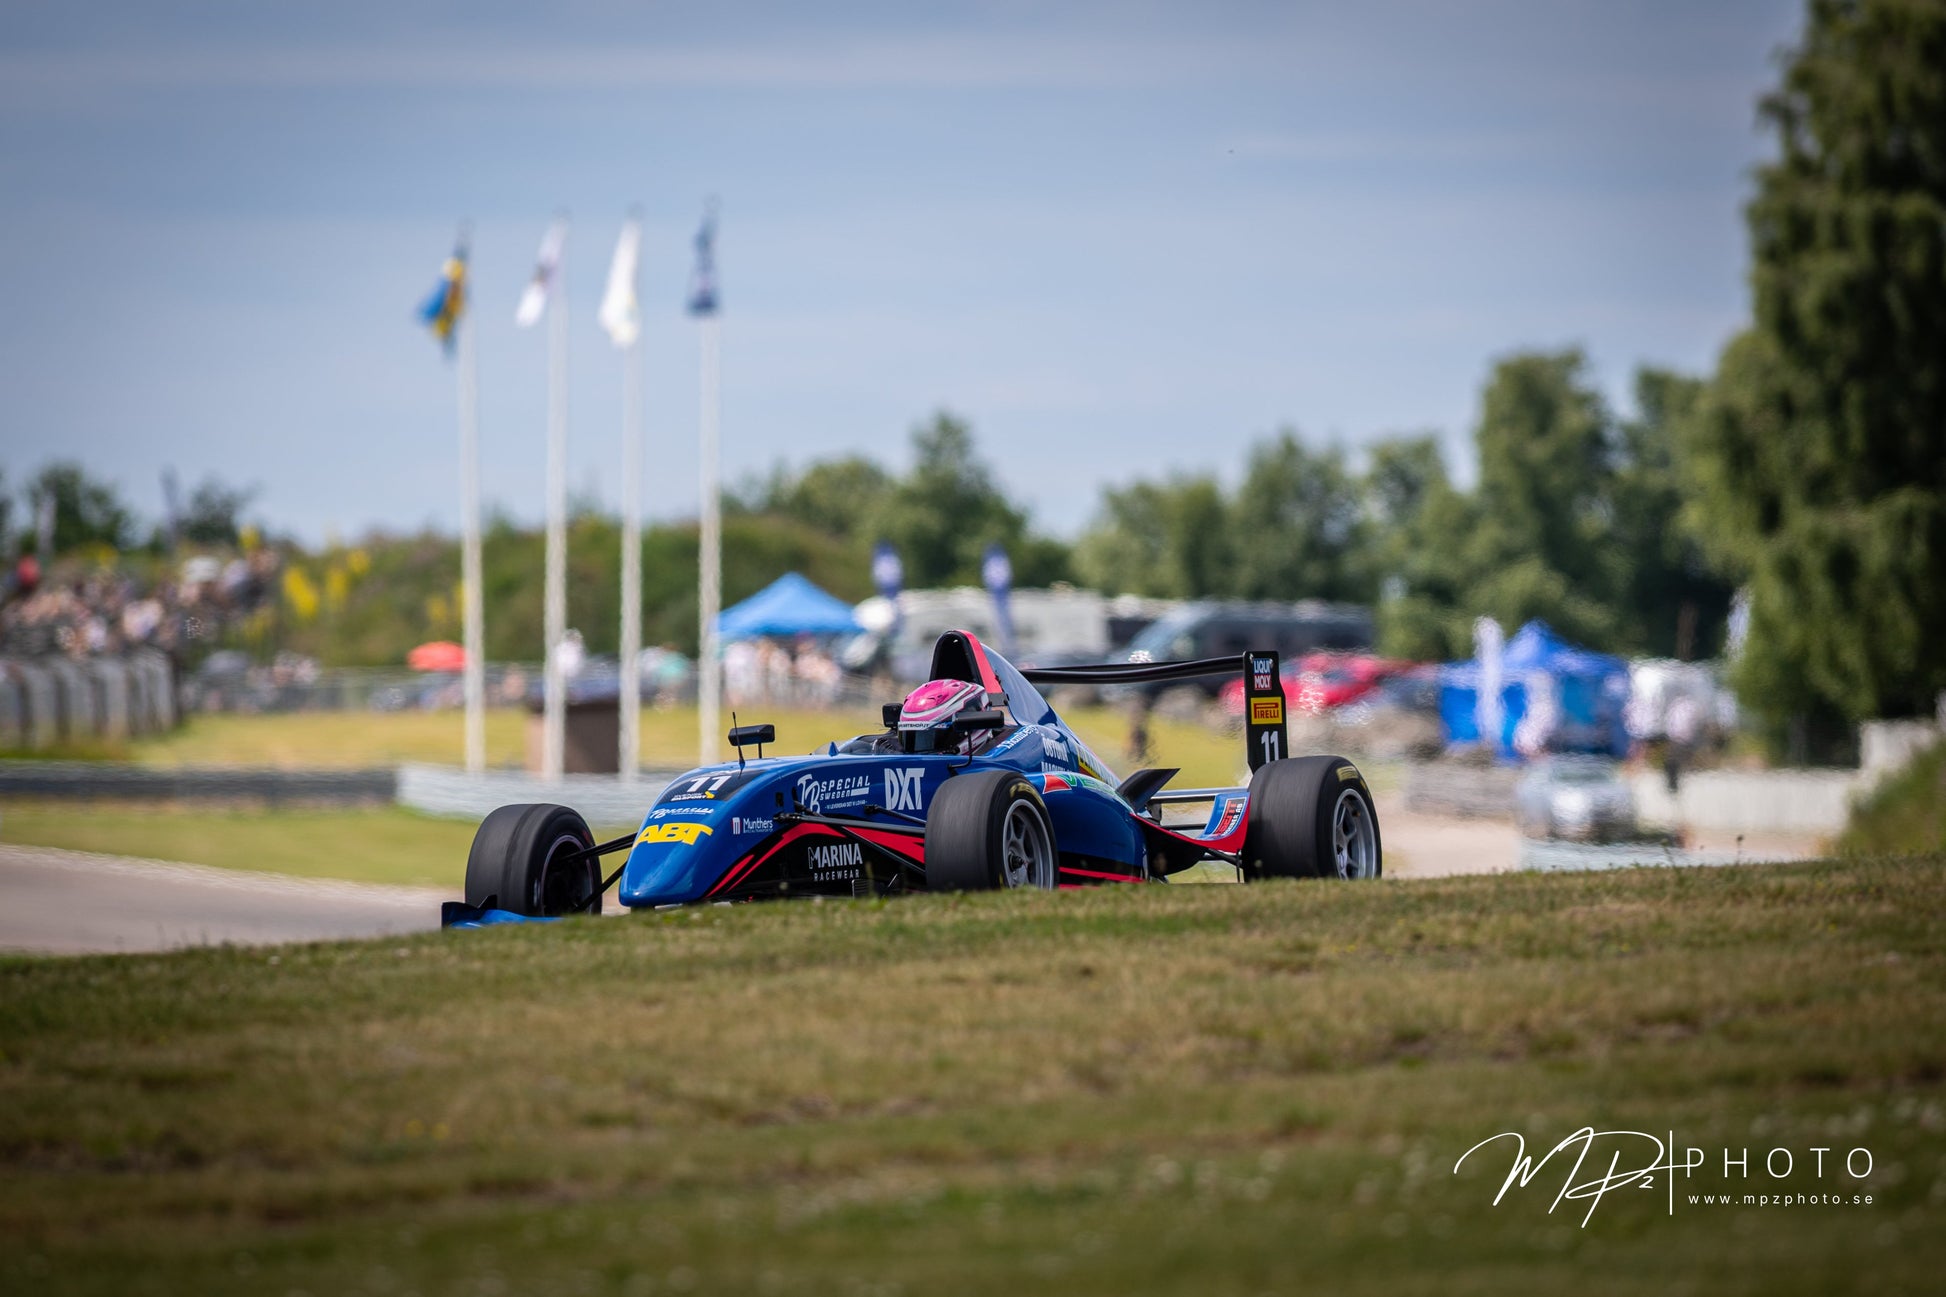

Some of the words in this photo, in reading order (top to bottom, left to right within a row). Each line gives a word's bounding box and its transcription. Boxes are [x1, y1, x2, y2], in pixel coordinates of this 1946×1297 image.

[1253, 660, 1271, 674] LIQUI
[1254, 675, 1271, 689] MOLY
[1253, 703, 1279, 719] PIRELLI
[1261, 731, 1279, 764] 11
[686, 775, 731, 792] 11
[820, 775, 871, 792] SPECIAL
[884, 768, 925, 811] DXT
[797, 774, 821, 815] TB
[820, 789, 850, 801] SWEDEN
[743, 817, 774, 832] Munthers
[633, 822, 714, 849] ABT
[808, 843, 863, 869] MARINA
[813, 869, 860, 881] RACEWEAR
